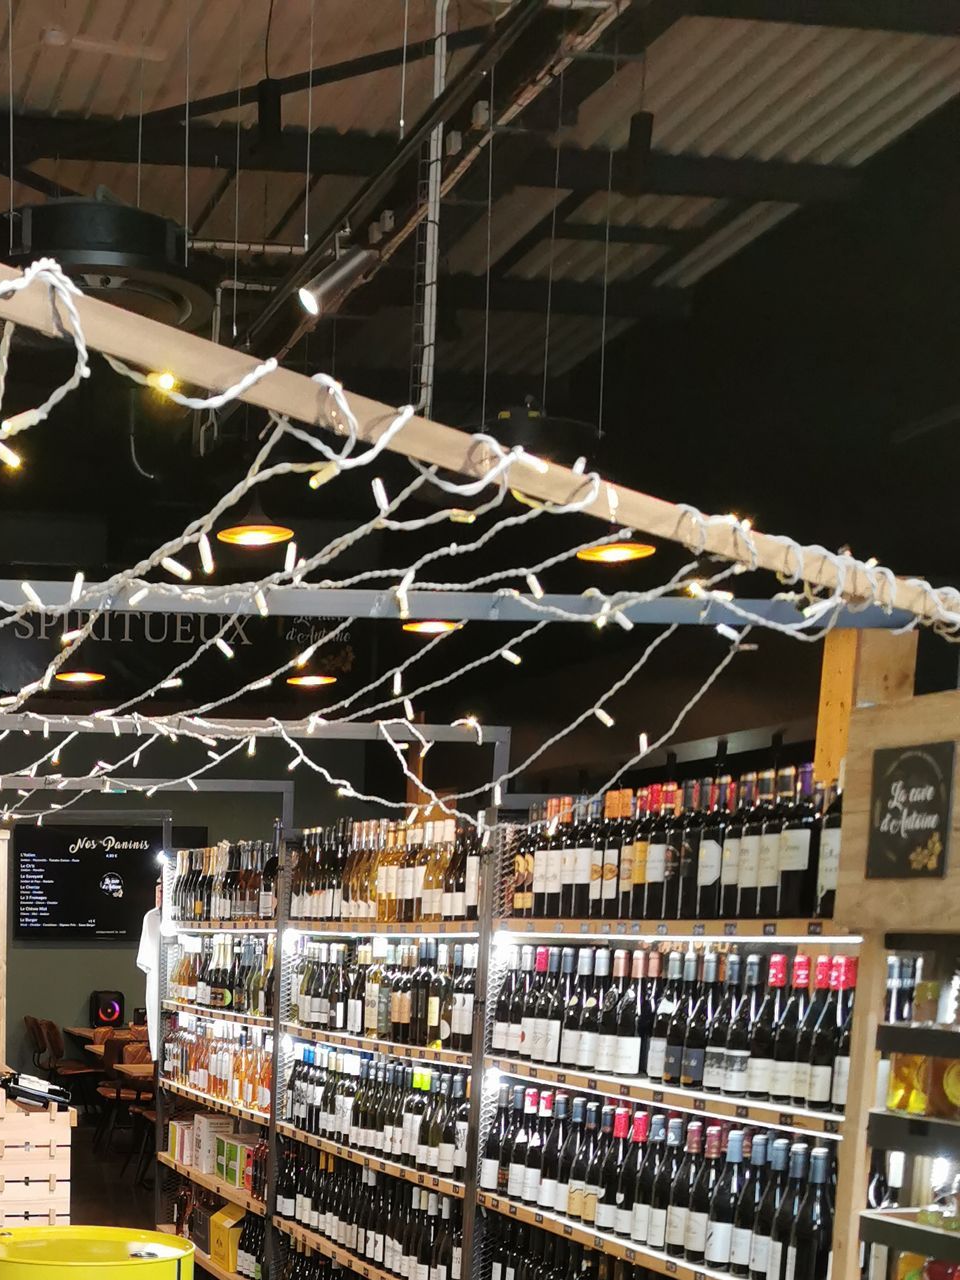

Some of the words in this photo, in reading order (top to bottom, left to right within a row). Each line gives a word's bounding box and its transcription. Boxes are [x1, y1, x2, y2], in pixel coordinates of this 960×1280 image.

[888, 780, 908, 811] La
[909, 784, 936, 803] cave
[68, 837, 98, 854] Nos
[99, 836, 150, 852] Paninis
